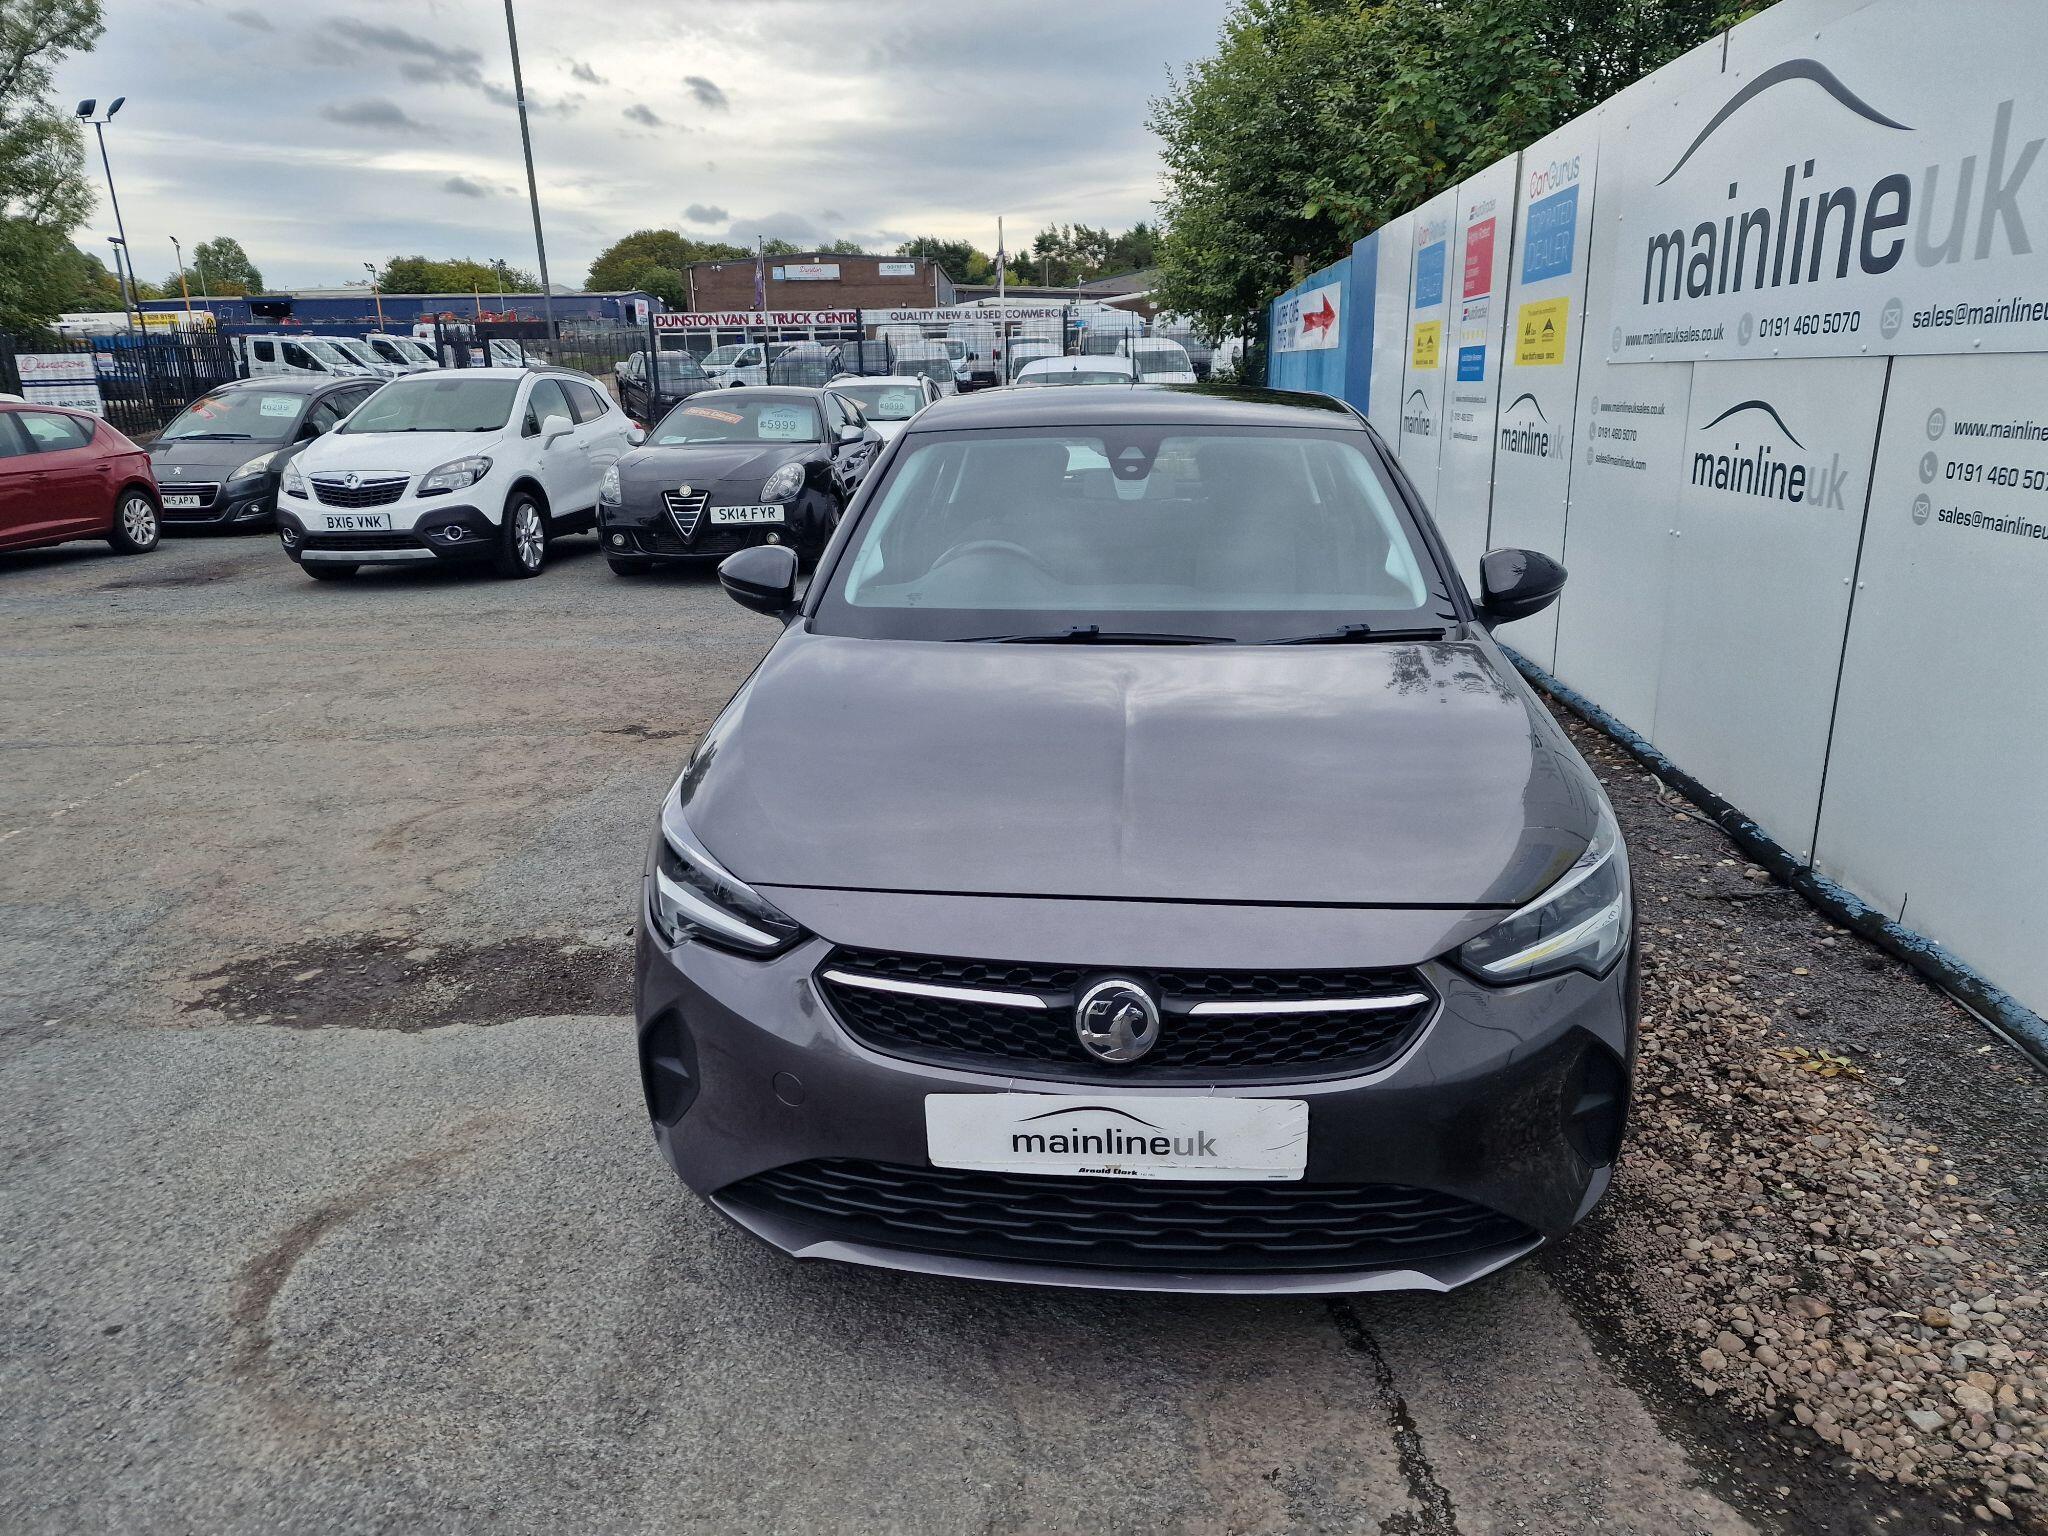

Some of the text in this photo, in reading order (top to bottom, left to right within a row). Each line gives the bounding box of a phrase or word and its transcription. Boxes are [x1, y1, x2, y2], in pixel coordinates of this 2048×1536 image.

[1529, 155, 1580, 199] CarGurus
[1643, 99, 2047, 305] mainlineuk
[1526, 230, 1570, 273] DEALER
[656, 311, 863, 327] DUNSTON VAN & TRUCK CENTR
[890, 311, 934, 322] QUALITY
[936, 310, 962, 320] NEW
[964, 310, 972, 320] &
[975, 309, 1002, 319] USED
[1625, 322, 1725, 347] www.mainlineuksales.co.uk
[1759, 316, 1790, 338] 0191
[1793, 314, 1820, 336] 460
[1822, 310, 1861, 333] 5070
[759, 419, 797, 430] £5999
[1500, 421, 1565, 460] mainlineuk
[1691, 442, 1849, 511] mainlineuk
[1945, 461, 1984, 482] 0191
[1987, 466, 2020, 488] 460
[178, 496, 195, 505] APX
[719, 506, 776, 520] SK14 FYR
[326, 516, 382, 529] BX16 VNK
[1012, 1127, 1218, 1158] mainlineuk
[1078, 1167, 1111, 1175] Arnold
[1113, 1168, 1138, 1176] Clark
